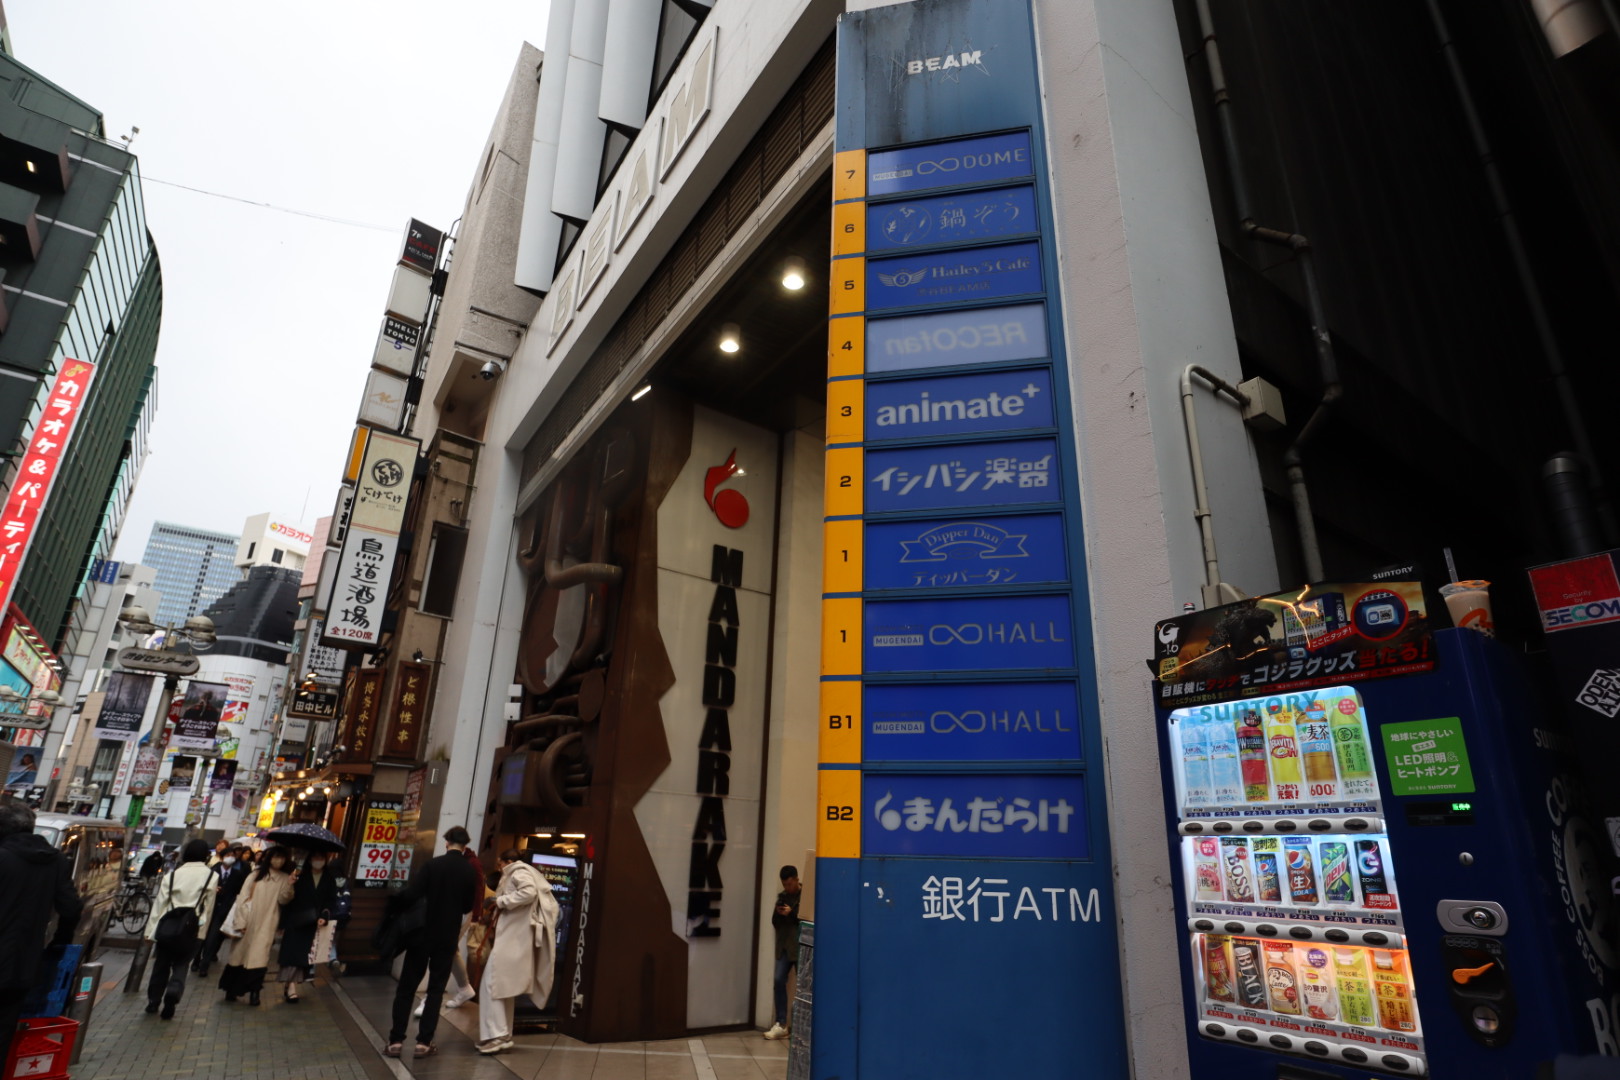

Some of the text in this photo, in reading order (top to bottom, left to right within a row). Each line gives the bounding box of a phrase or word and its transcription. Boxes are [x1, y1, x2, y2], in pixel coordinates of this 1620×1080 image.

[907, 50, 983, 75] BEAM
[962, 148, 1027, 170] DOME
[845, 170, 856, 179] 7
[939, 201, 1020, 230] 鍋ぞう
[844, 224, 855, 233] 6
[844, 280, 855, 290] 5
[388, 320, 417, 336] SHELL
[387, 329, 416, 344] TOKYO
[842, 341, 853, 351] 4
[841, 406, 852, 417] 3
[840, 476, 851, 487] 2
[871, 454, 1053, 496] イシバシ楽器
[363, 486, 403, 504] てけてけ
[923, 526, 1001, 548] Dipper Dan
[841, 550, 849, 563] 1
[1372, 566, 1414, 581] SUNTORY
[1562, 590, 1592, 600] Security
[330, 626, 374, 641] 全120席
[840, 630, 848, 643] 1
[987, 621, 1066, 644] HALL
[875, 636, 923, 646] MUGENDAI
[294, 700, 333, 714] 田中ビル
[1200, 690, 1320, 724] SUNTORY
[829, 715, 852, 729] B1
[874, 722, 924, 733] MUGENDAI
[991, 710, 1072, 733] HALL
[1306, 723, 1330, 741] 麦茶
[1390, 729, 1455, 742] 地球にやさしい
[685, 543, 744, 938] MANDARAKE
[1394, 751, 1459, 767] LED照明&
[1397, 763, 1461, 779] ヒートポンプ
[826, 806, 853, 821] B2
[902, 796, 1075, 834] まんだらけ
[366, 825, 396, 841] 180
[367, 848, 393, 864] 99
[365, 869, 388, 878] 140
[1227, 855, 1251, 897] BOSS
[1550, 828, 1577, 925] COFFEE
[1293, 875, 1305, 889] 生
[921, 875, 1102, 923] 銀行ATM
[569, 862, 595, 1019] MANDARAKE
[1236, 954, 1264, 1005] BLACK
[1345, 981, 1355, 992] 茶
[1384, 985, 1394, 996] 茶
[1400, 1021, 1412, 1029] 280
